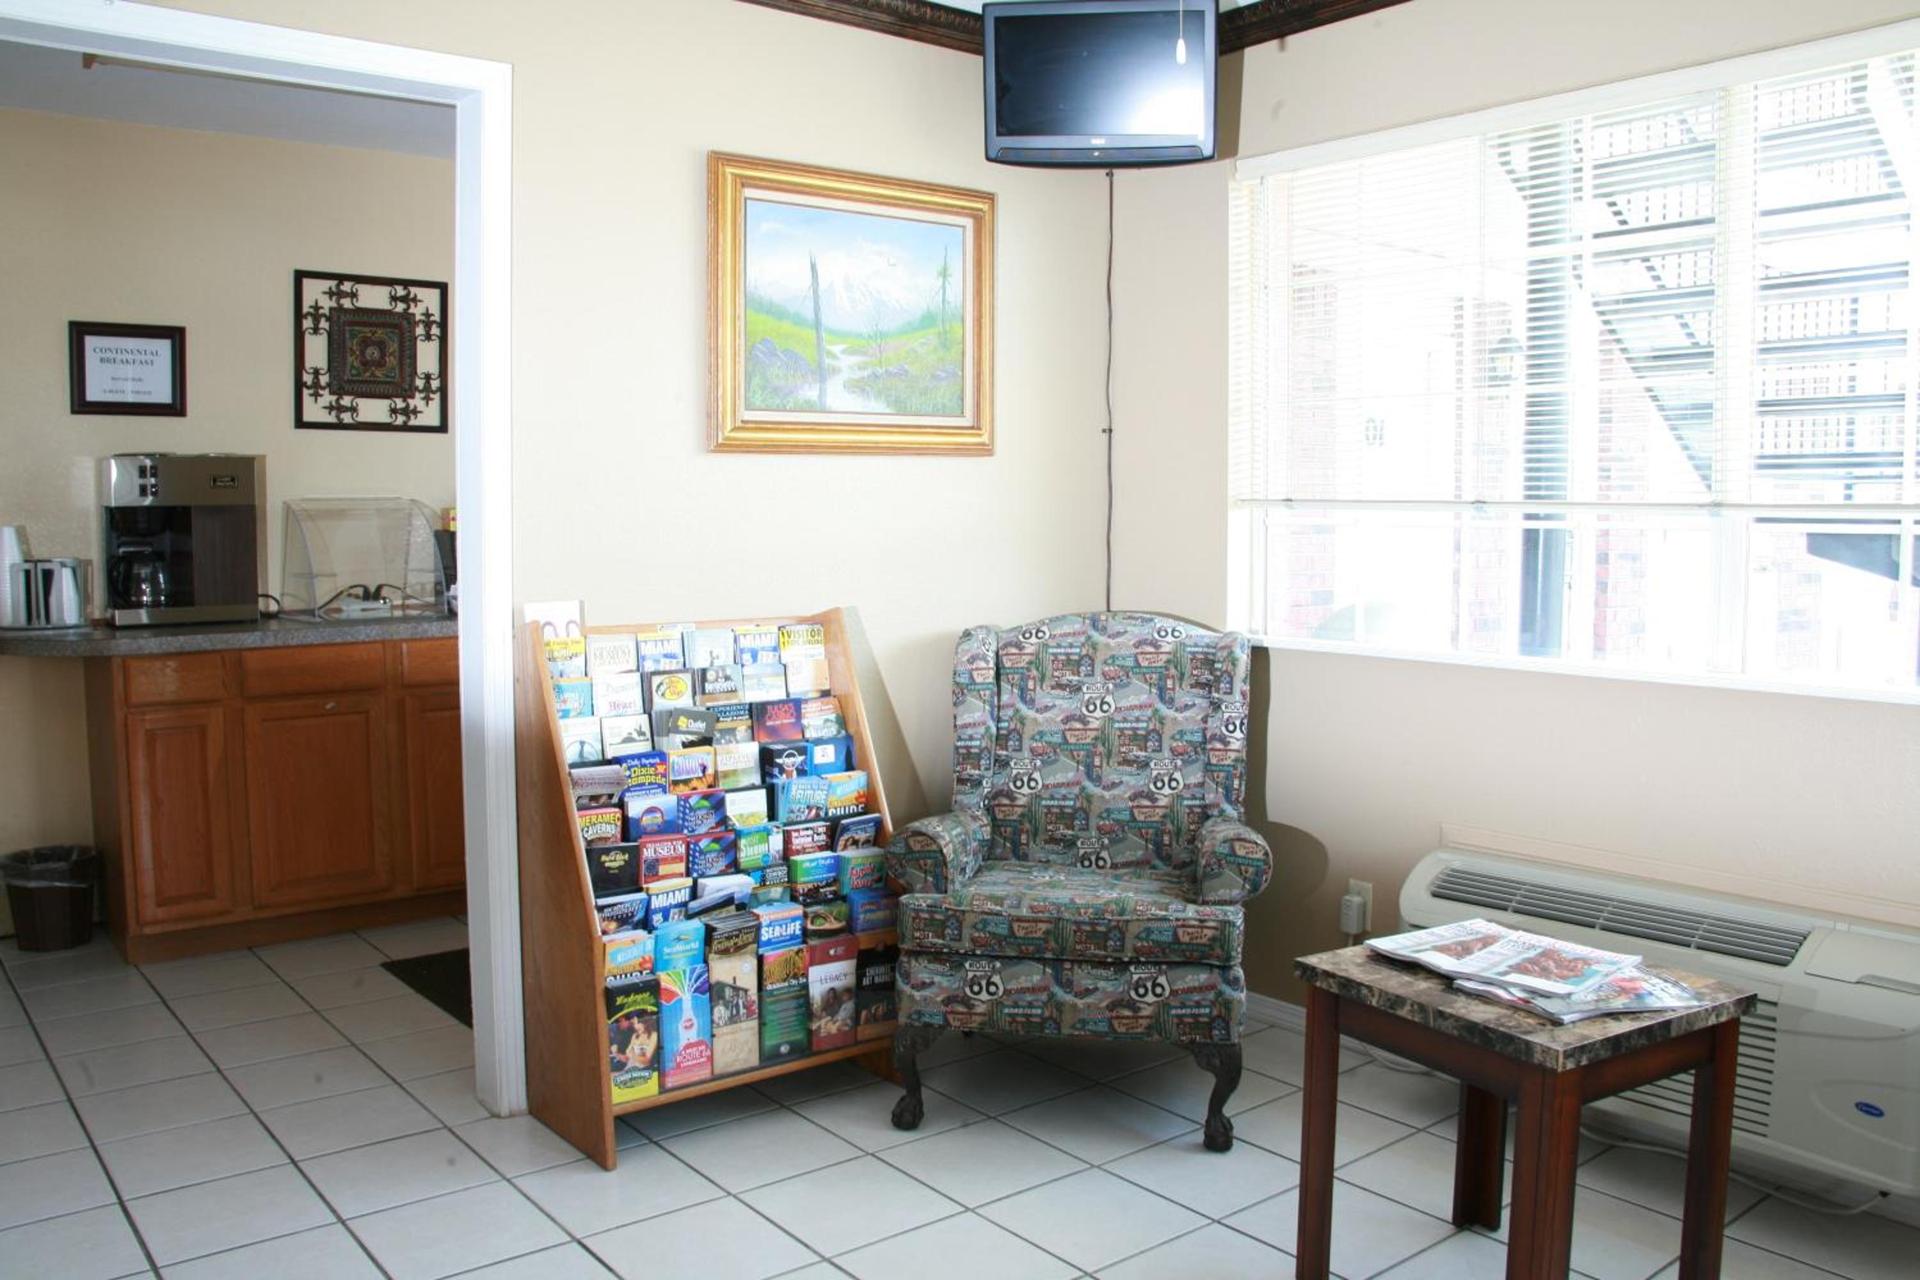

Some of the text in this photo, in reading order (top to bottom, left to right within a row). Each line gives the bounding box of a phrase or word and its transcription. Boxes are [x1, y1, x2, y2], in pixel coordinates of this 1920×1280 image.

[93, 346, 161, 357] CONTINENTAL
[99, 356, 154, 367] BREAKFAST
[1021, 627, 1047, 640] 66
[1157, 625, 1183, 639] 66
[1085, 695, 1112, 714] 66
[1224, 703, 1245, 711] ROUT
[1013, 771, 1039, 790] 66
[1153, 772, 1180, 791] 66
[643, 843, 686, 858] MUSEUM
[1081, 852, 1108, 869] 66
[651, 888, 690, 909] MIAMI
[820, 972, 848, 985] LEGACY
[969, 974, 1000, 996] 66
[1134, 976, 1166, 998] 66
